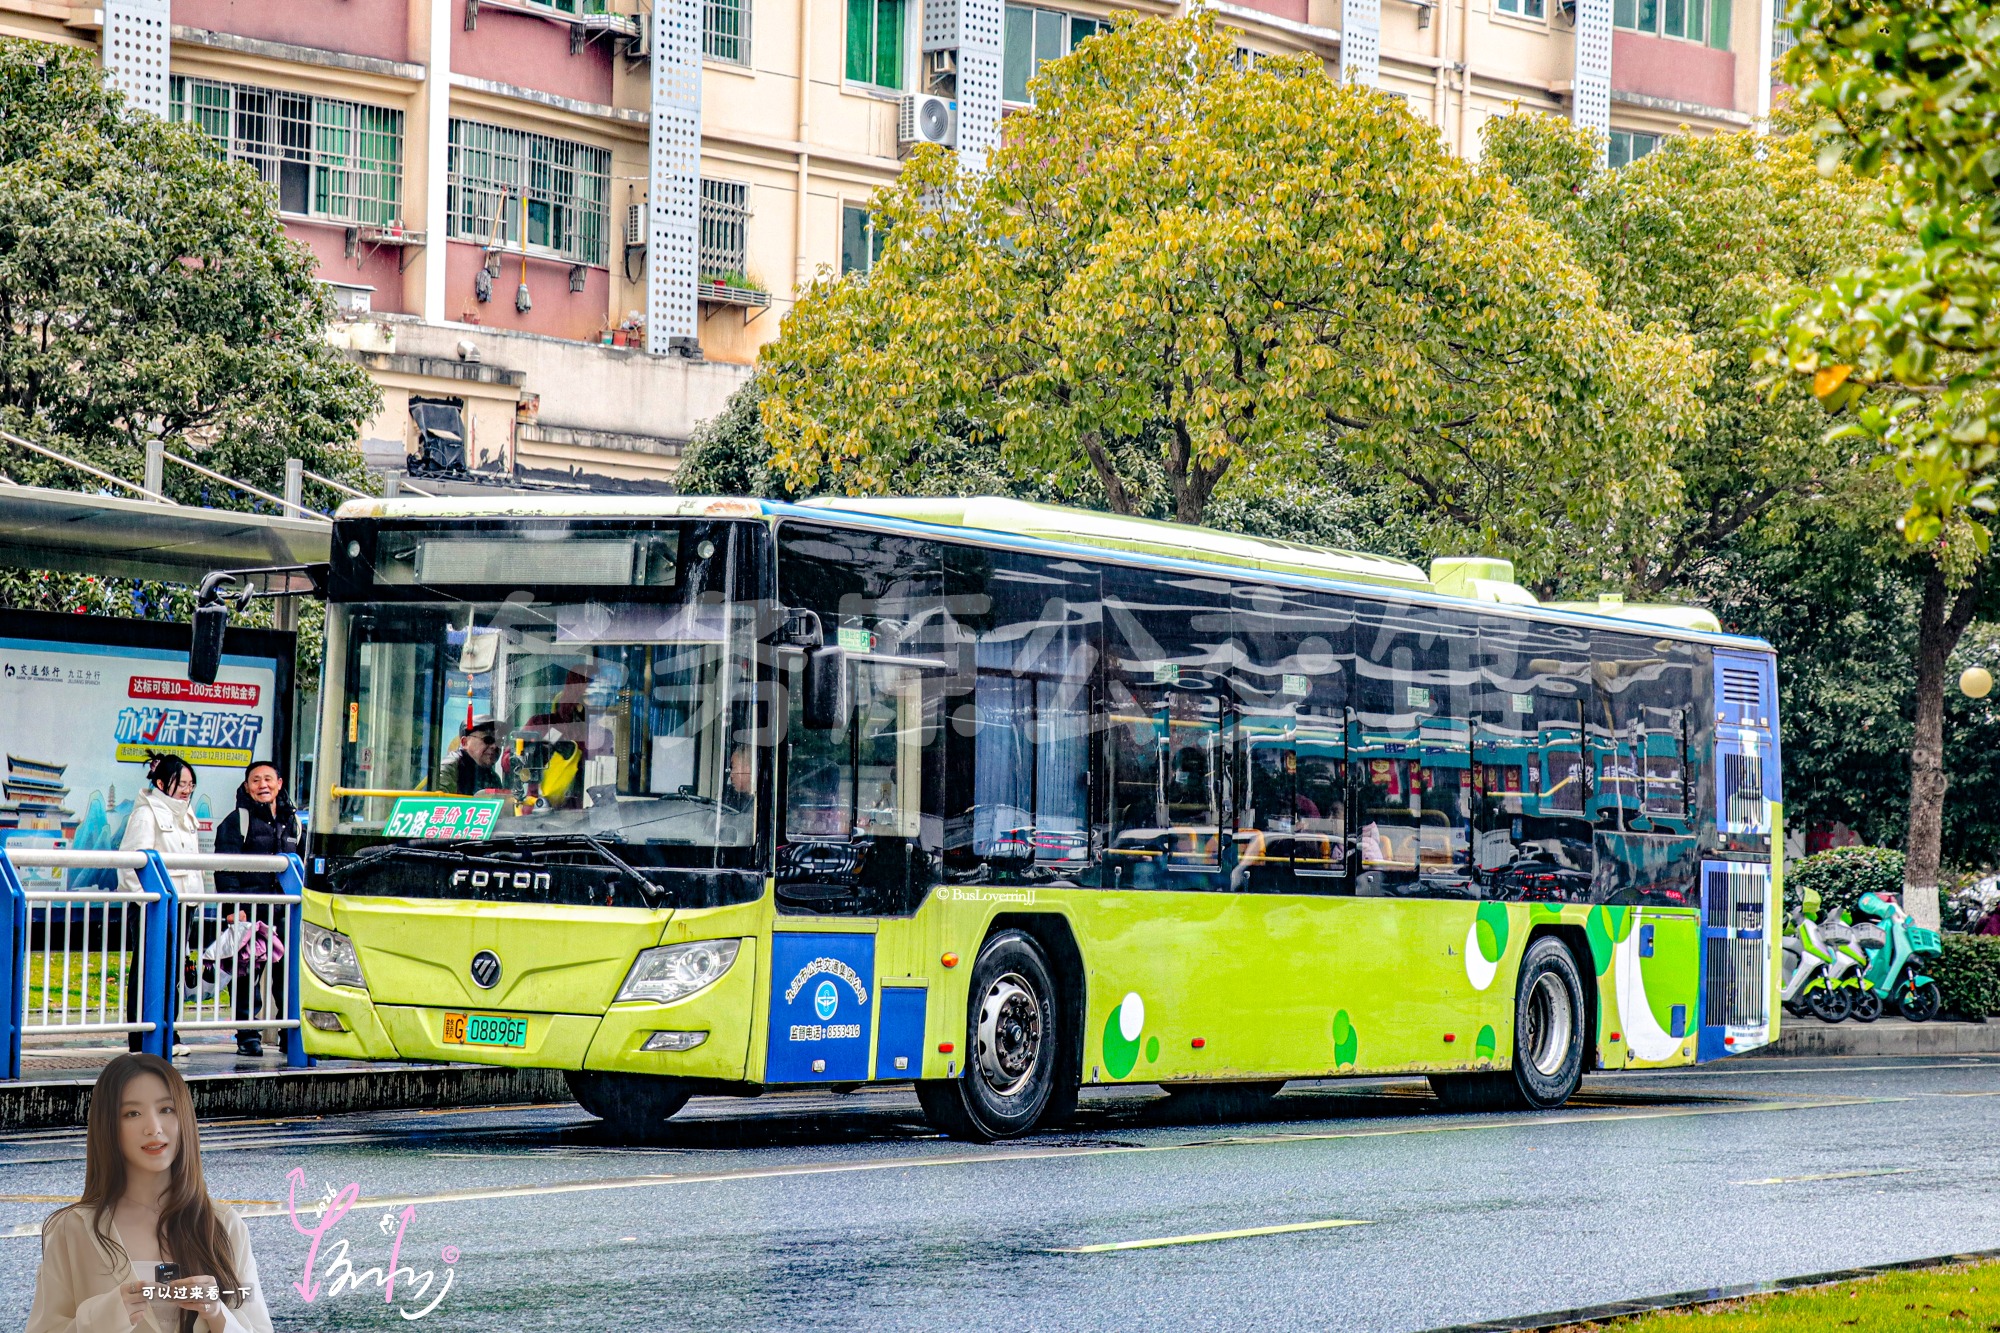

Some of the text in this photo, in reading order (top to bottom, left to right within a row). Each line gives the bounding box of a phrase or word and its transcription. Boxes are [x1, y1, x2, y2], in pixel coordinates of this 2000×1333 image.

[68, 669, 101, 680] 九江分行
[116, 708, 259, 748] 办社保卡到交行
[389, 810, 430, 836] 52路
[451, 869, 551, 890] FOTON
[785, 957, 868, 1005] 九江市公共交通集团公司
